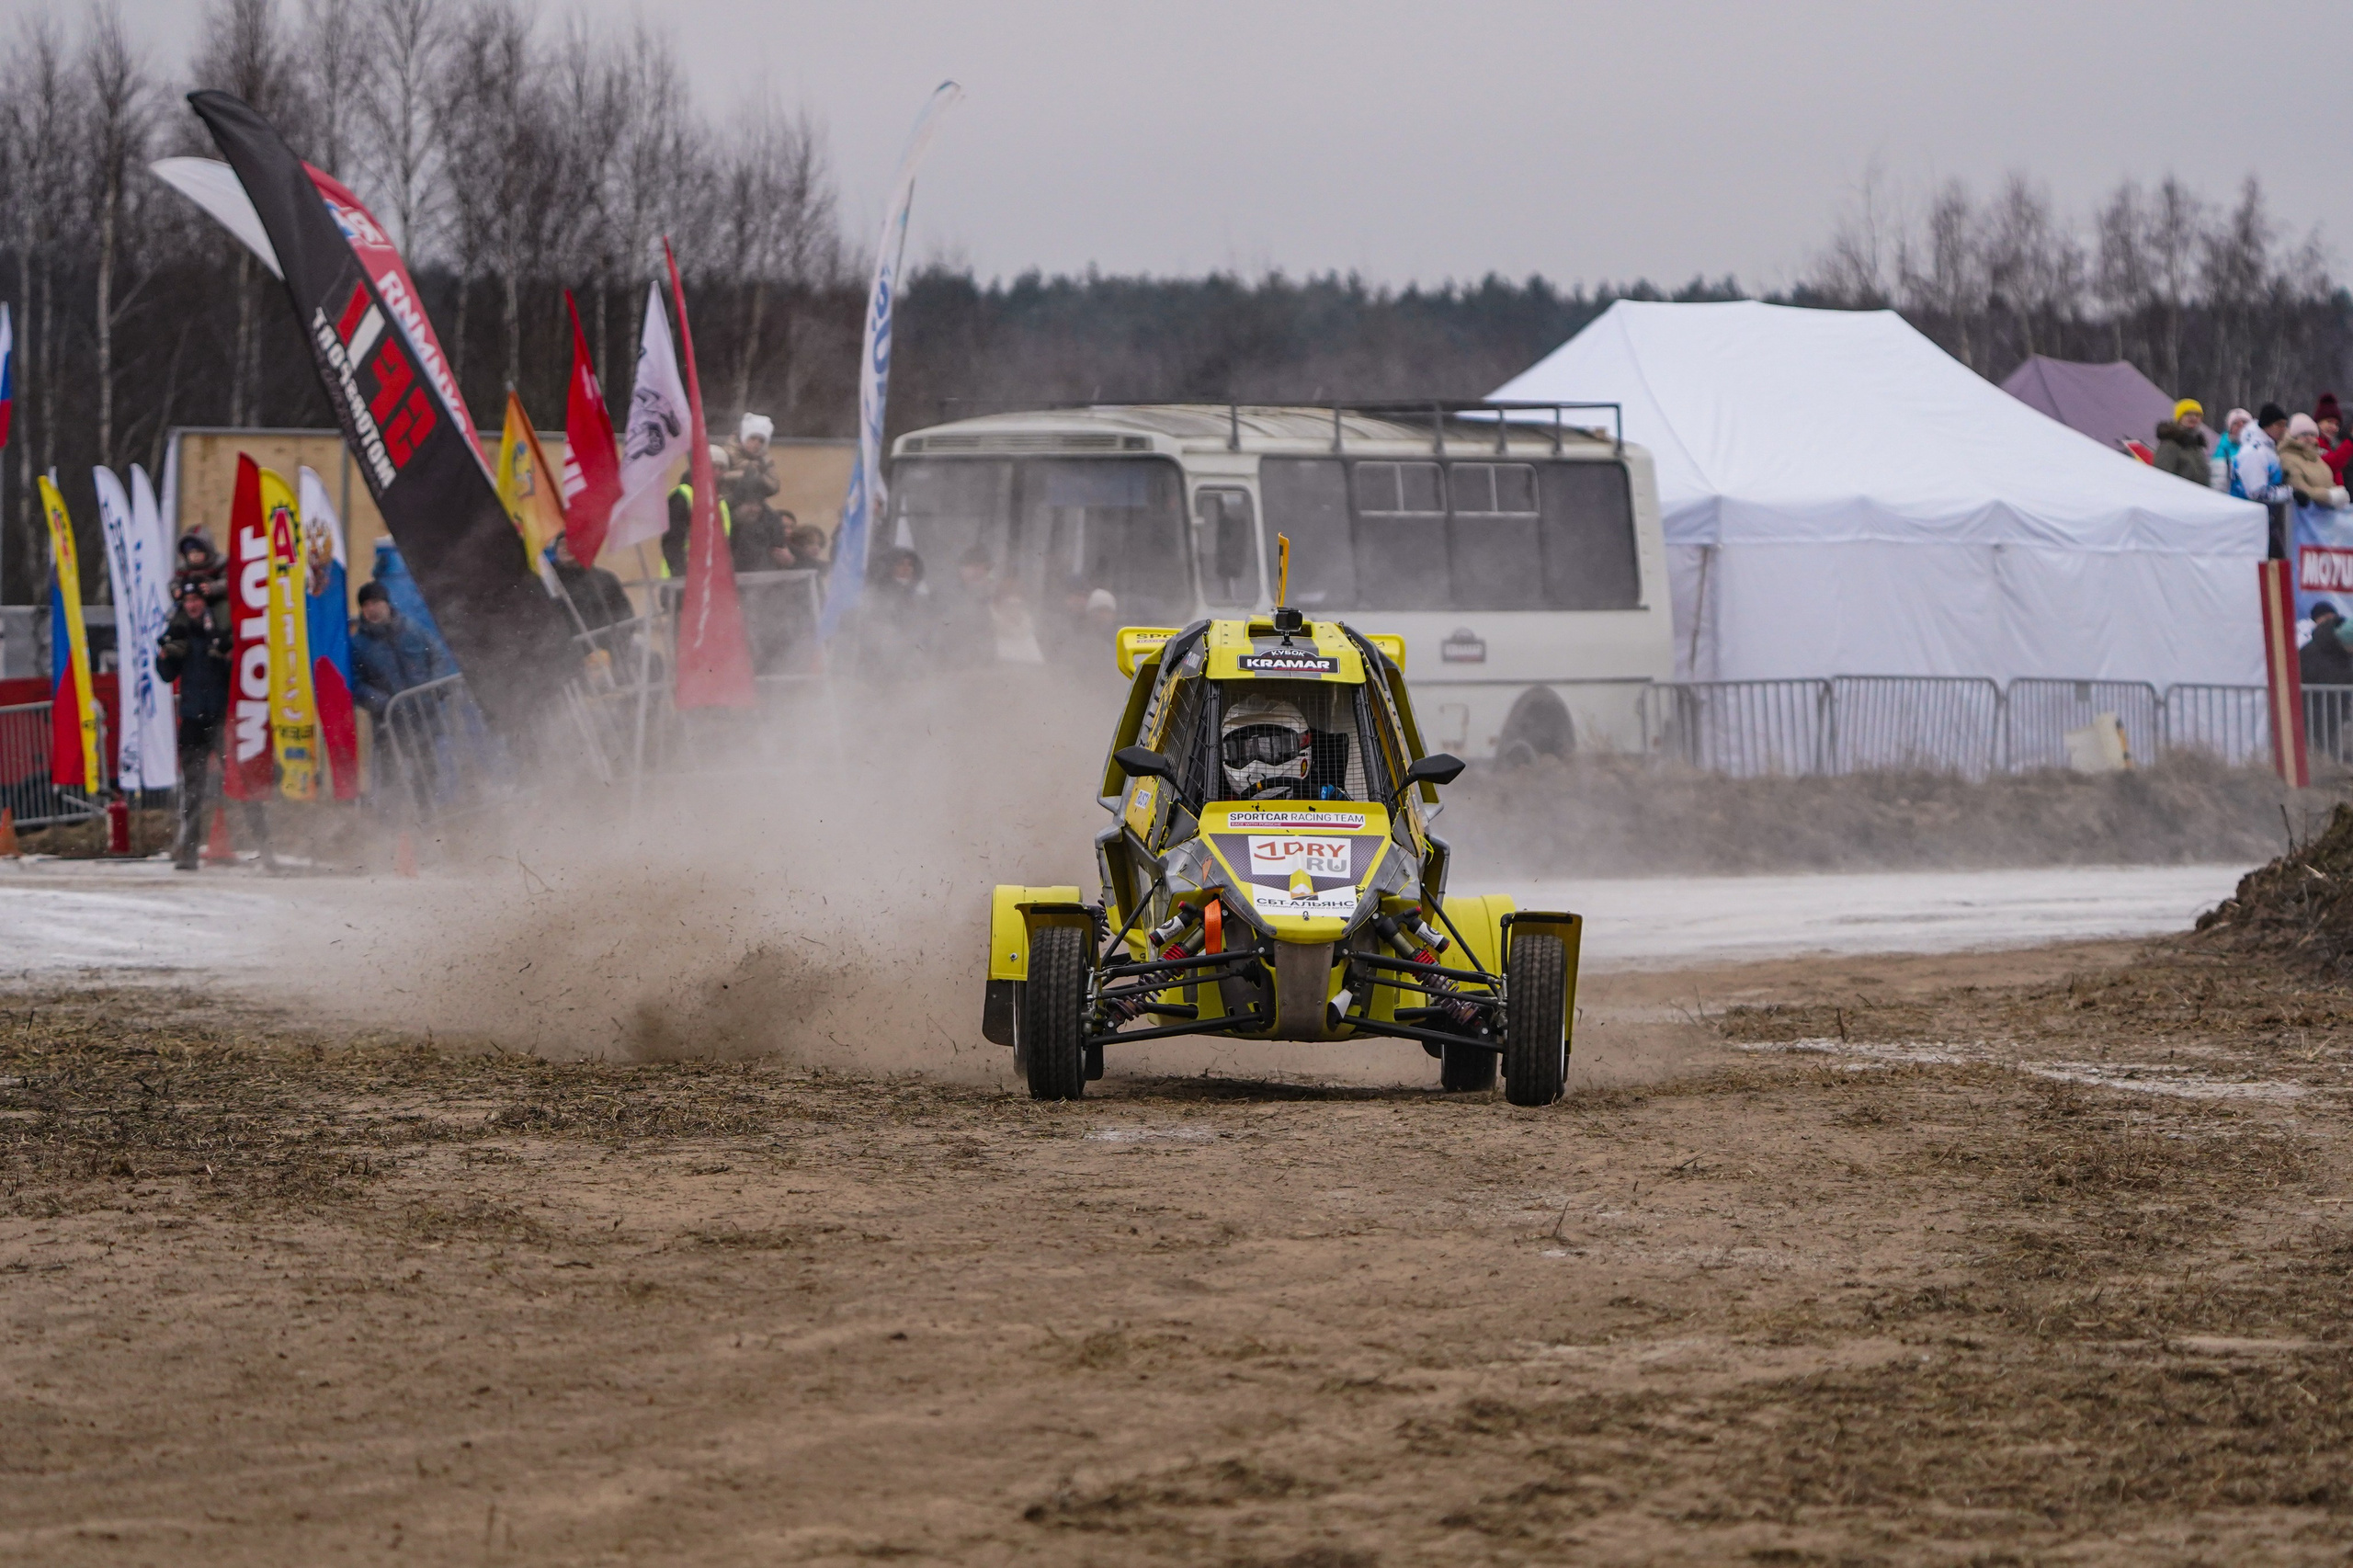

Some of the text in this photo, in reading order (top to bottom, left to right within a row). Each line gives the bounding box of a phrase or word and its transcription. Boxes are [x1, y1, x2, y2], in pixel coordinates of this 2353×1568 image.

[2302, 551, 2353, 588] MOTU
[1246, 659, 1330, 669] KRAMAR
[1230, 812, 1364, 823] SPORTCAR RACING TEAM
[1306, 858, 1347, 872] RU
[1256, 898, 1354, 907] СБТ-АЛЬЯНС
